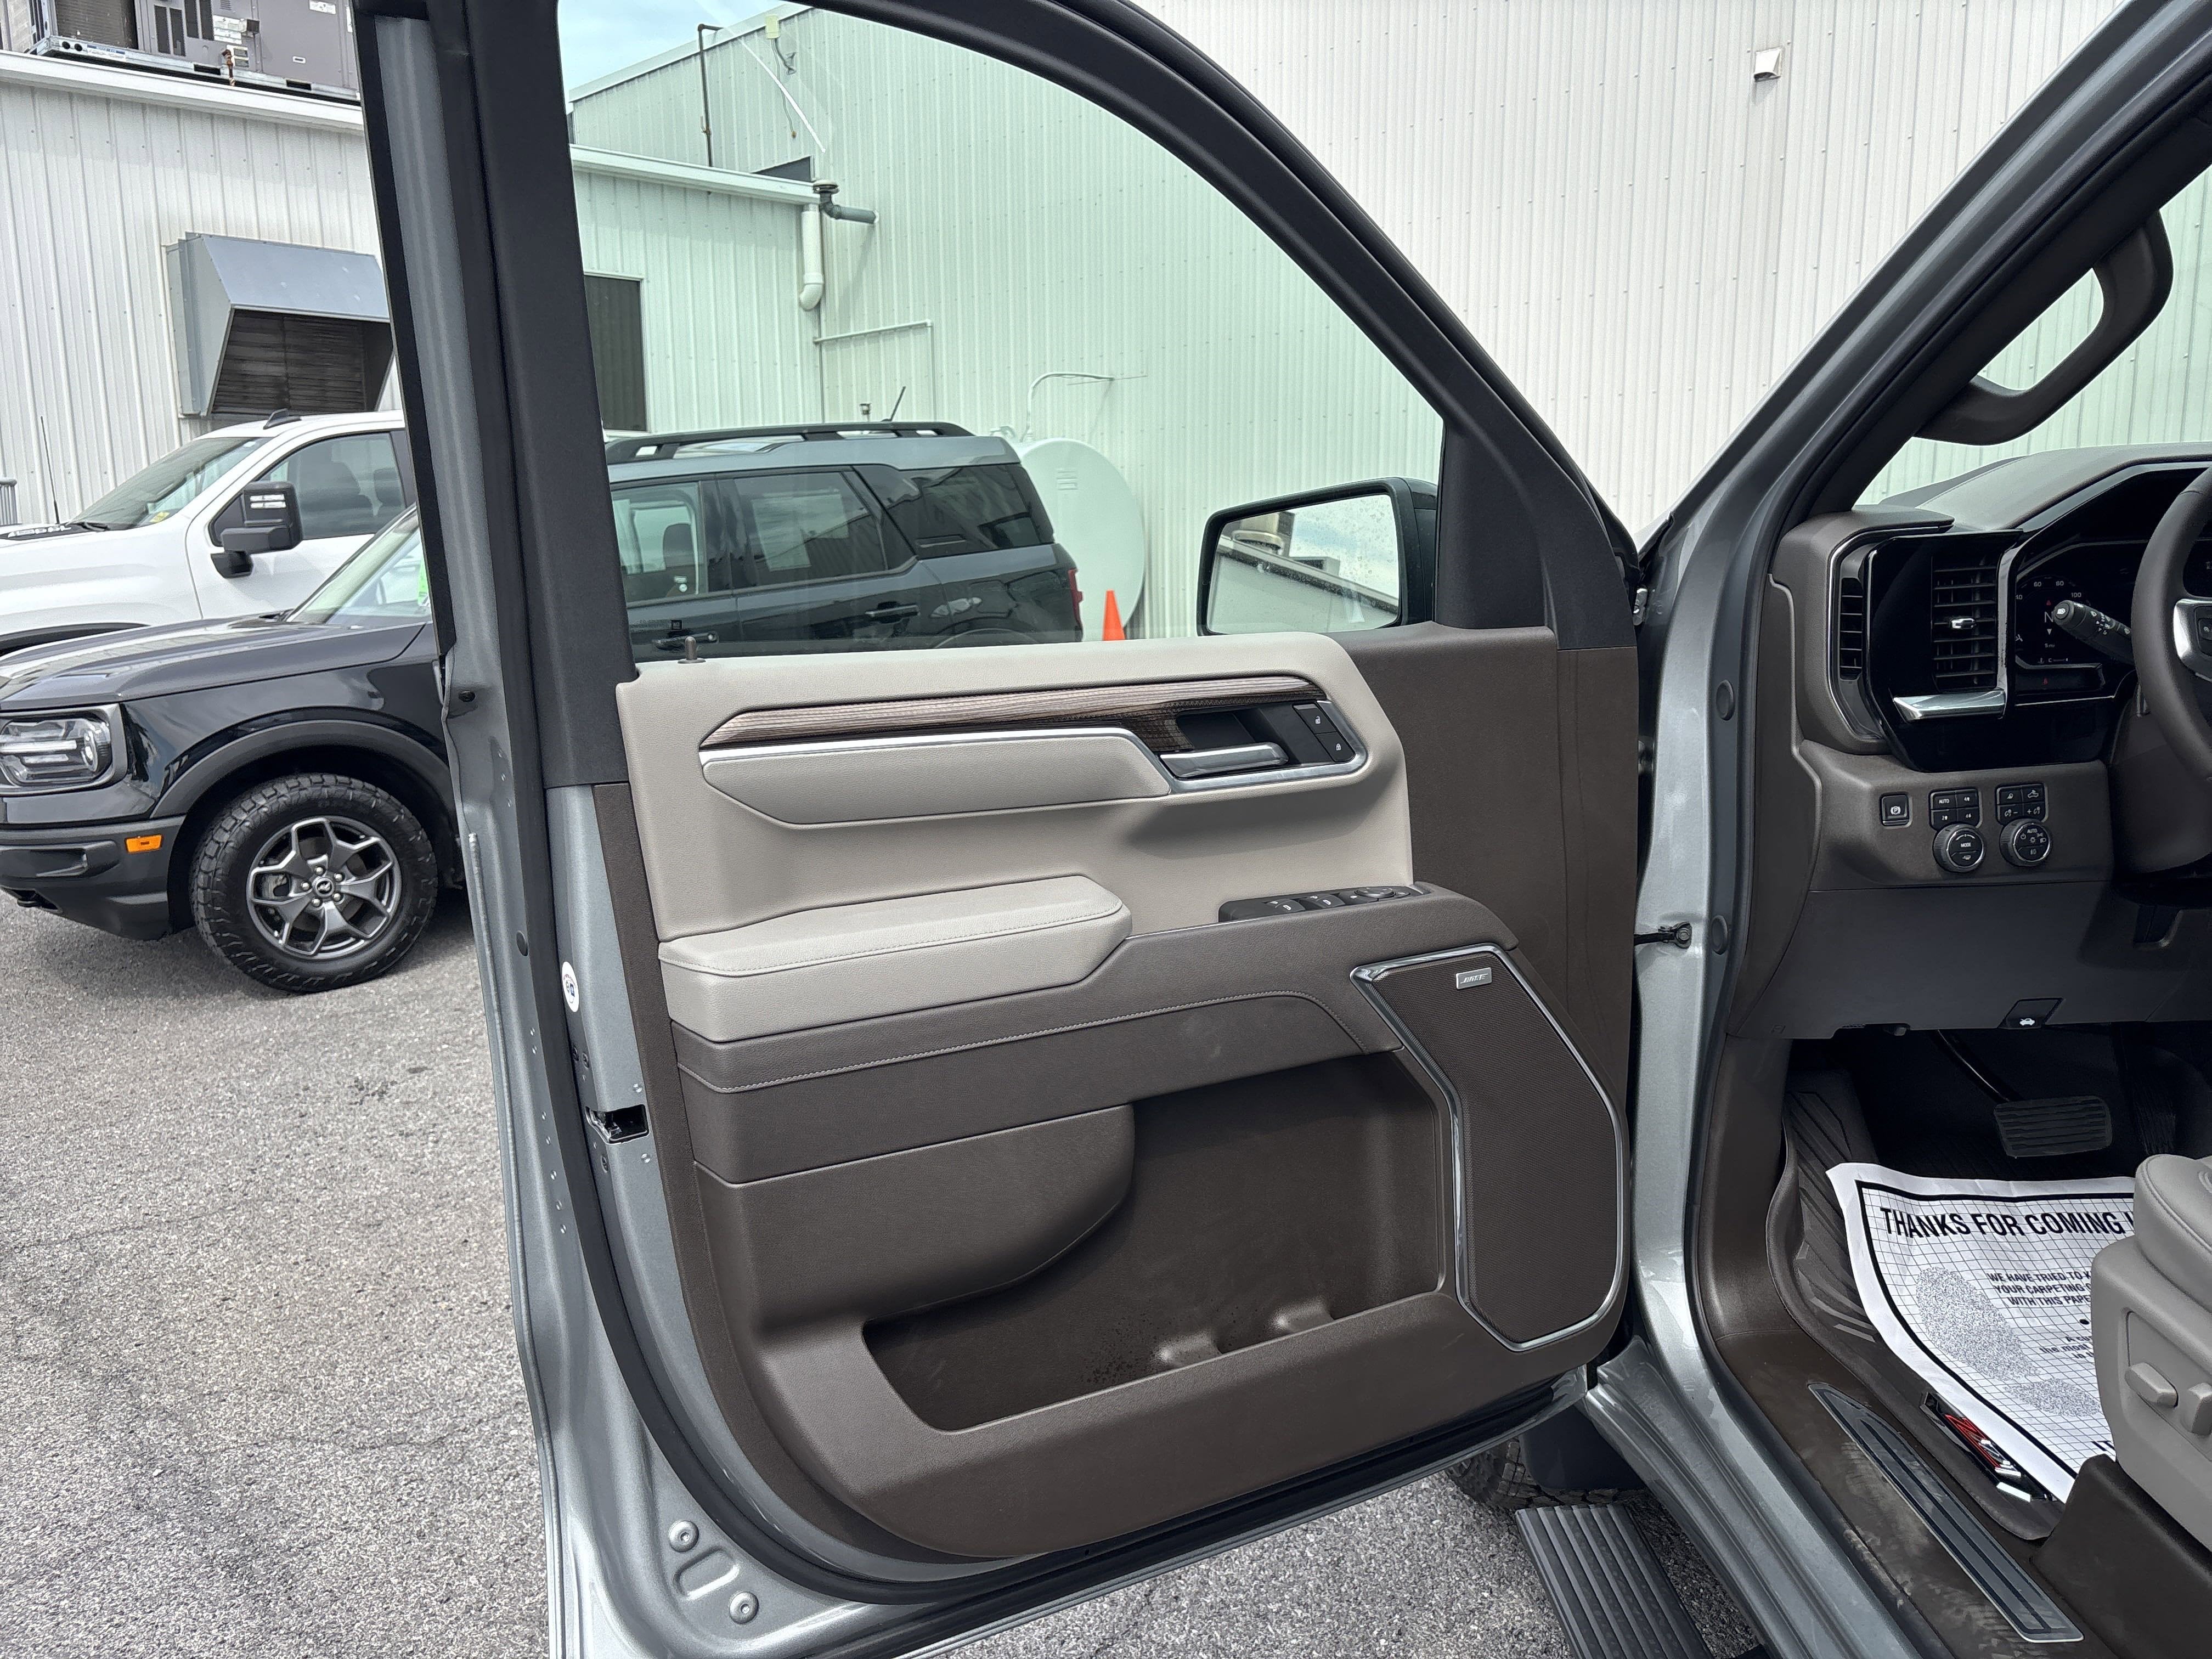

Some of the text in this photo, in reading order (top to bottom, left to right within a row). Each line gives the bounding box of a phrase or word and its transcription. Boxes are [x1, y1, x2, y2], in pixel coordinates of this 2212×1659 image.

[2044, 611, 2053, 623] N
[1880, 1207, 1971, 1238] THANKS
[1971, 1213, 2025, 1236] FOR
[2024, 1212, 2126, 1235] COMING
[1987, 1273, 2005, 1282] WE
[2005, 1273, 2034, 1282] HAVE
[2033, 1272, 2067, 1282] TRIED
[2066, 1271, 2083, 1280] TO
[1994, 1285, 2025, 1294] YOUR
[2025, 1283, 2085, 1294] CARPETING
[2007, 1296, 2036, 1305] WITH
[2038, 1296, 2063, 1305] THIS
